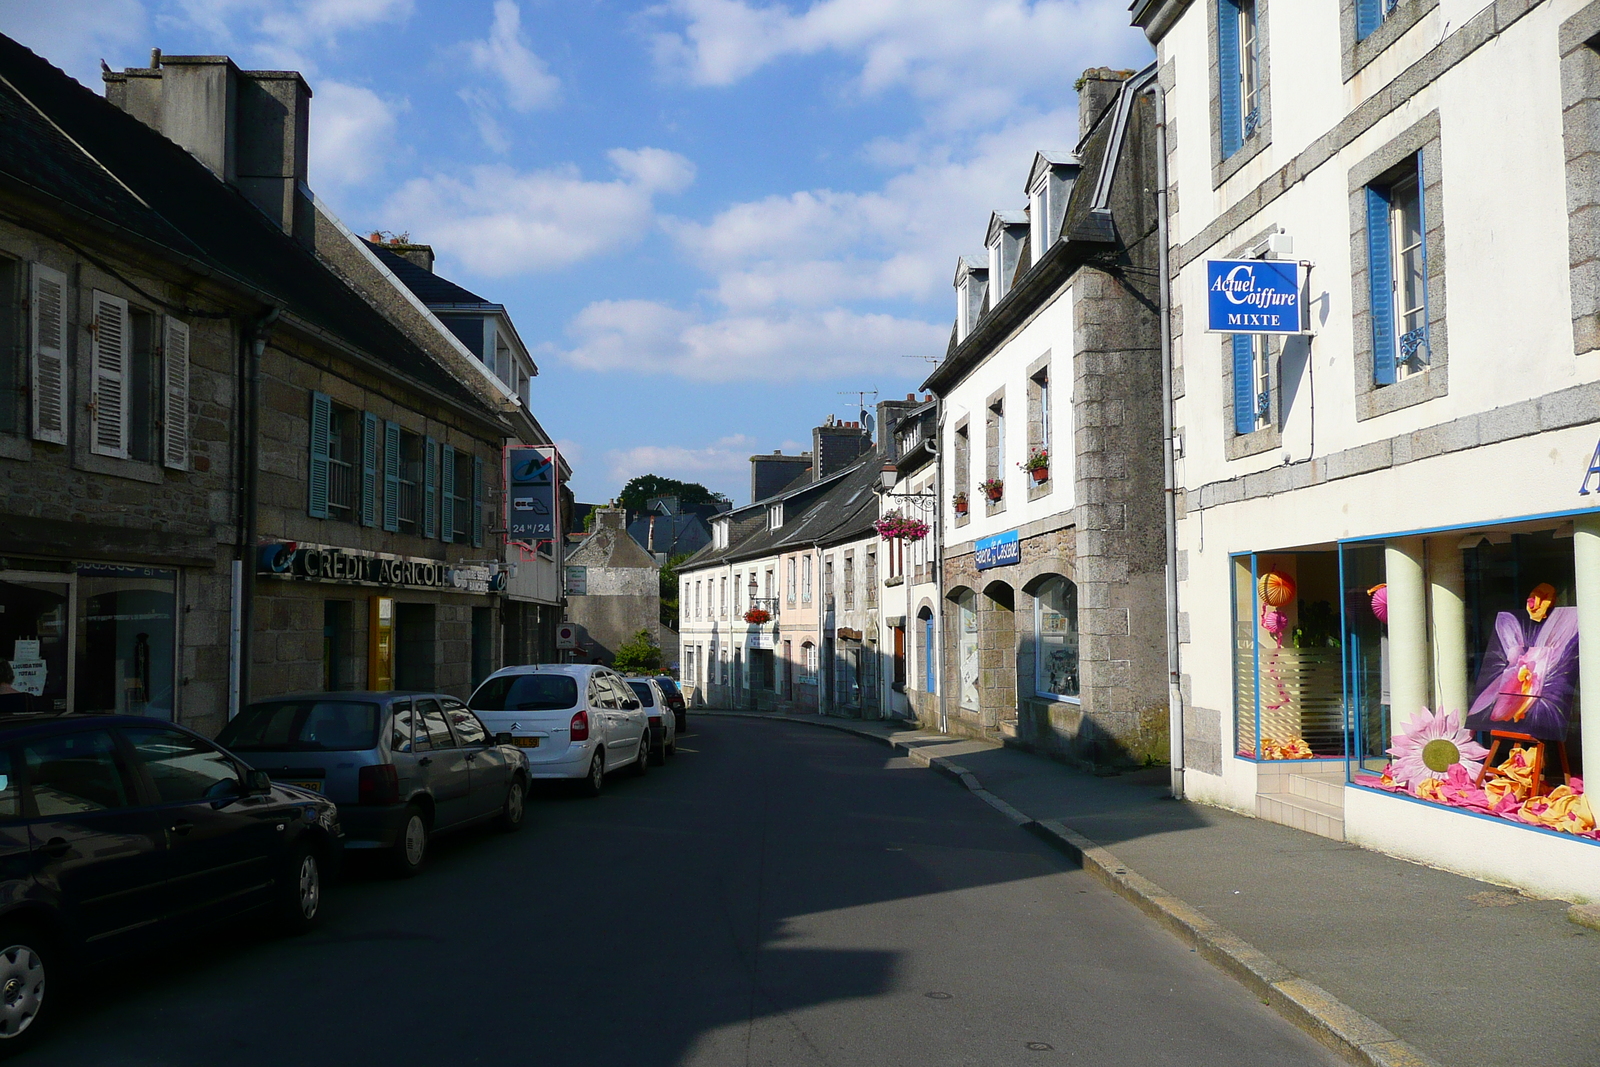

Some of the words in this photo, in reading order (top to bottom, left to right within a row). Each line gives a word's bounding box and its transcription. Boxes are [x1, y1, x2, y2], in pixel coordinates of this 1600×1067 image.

[1211, 274, 1256, 292] Actuel
[1225, 265, 1296, 308] Coiffure
[1228, 314, 1280, 325] MIXTE
[512, 524, 525, 533] 24
[991, 539, 997, 550] de
[997, 539, 1018, 560] Cascade
[975, 546, 991, 564] Galerie
[992, 554, 997, 565] la
